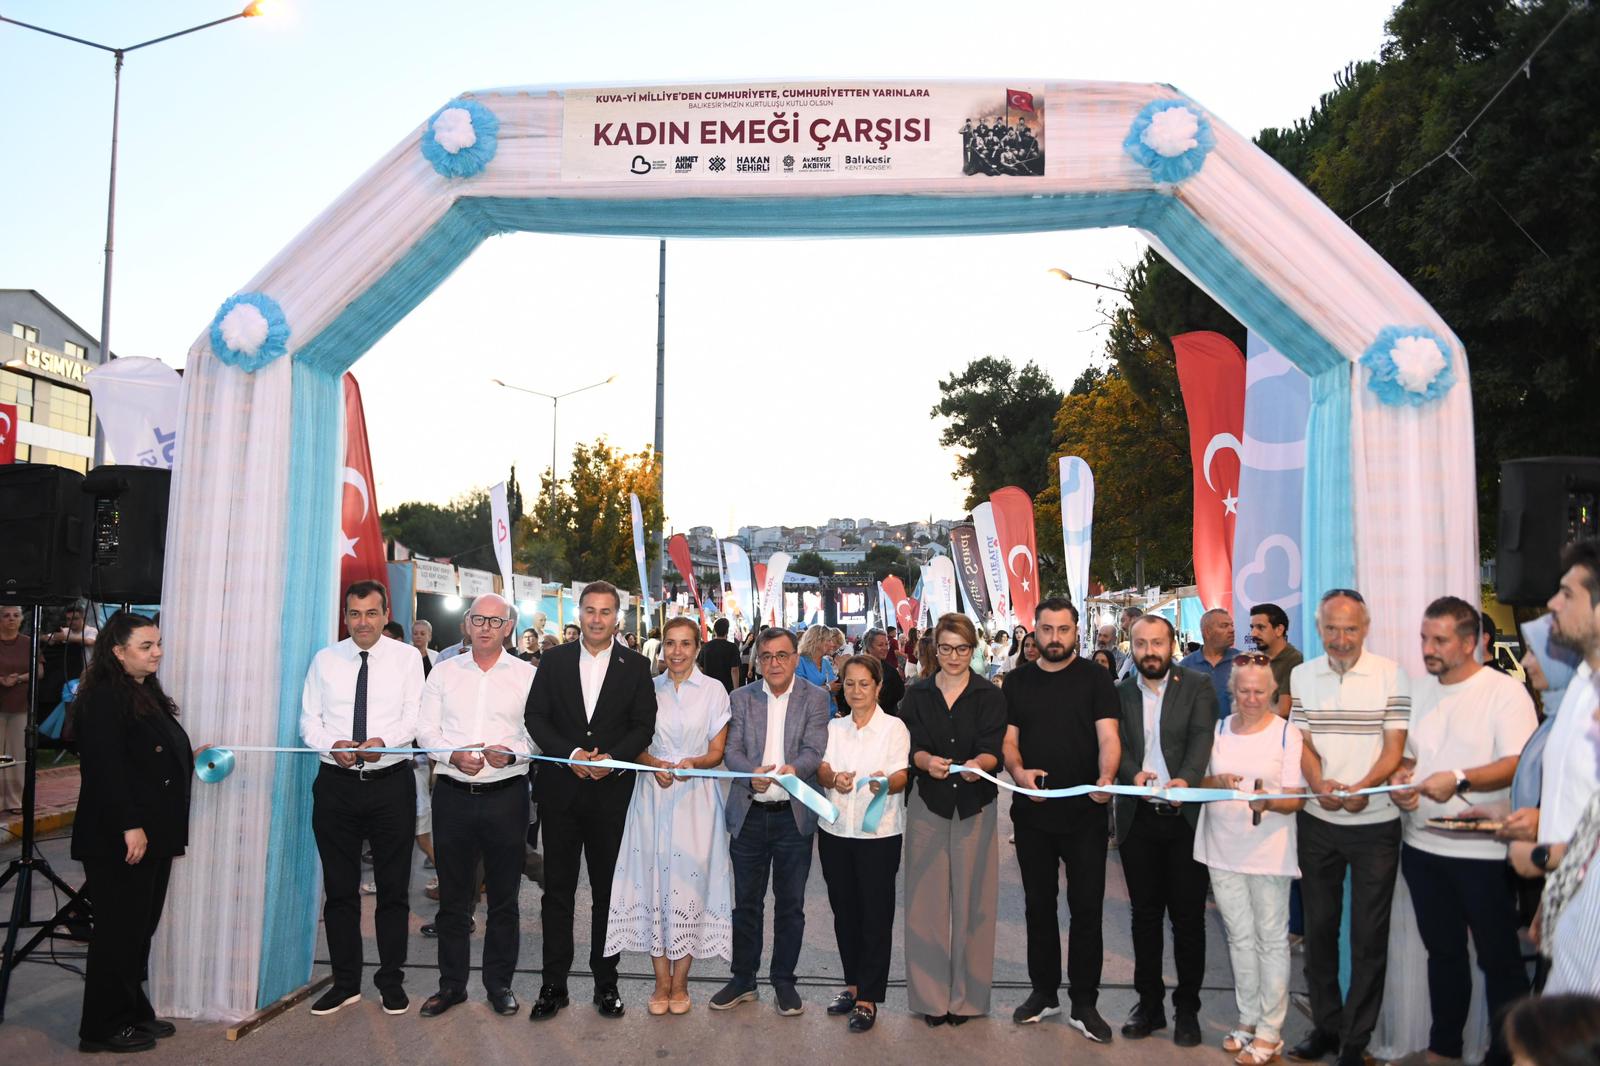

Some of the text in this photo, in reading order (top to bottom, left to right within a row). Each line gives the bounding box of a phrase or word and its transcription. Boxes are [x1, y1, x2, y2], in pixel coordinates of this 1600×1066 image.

[595, 87, 930, 103] KUVA-Yİ MİLLİYE'DEN CUMHURİYETE, CUMHURİYETTEN YARINLARA
[745, 100, 785, 109] KURTULUŞU
[809, 99, 834, 107] OLSUN
[593, 112, 931, 151] KADIN EMEĞİ ÇARŞISI
[736, 156, 770, 164] HAKAN
[845, 155, 892, 165] Balıkesir
